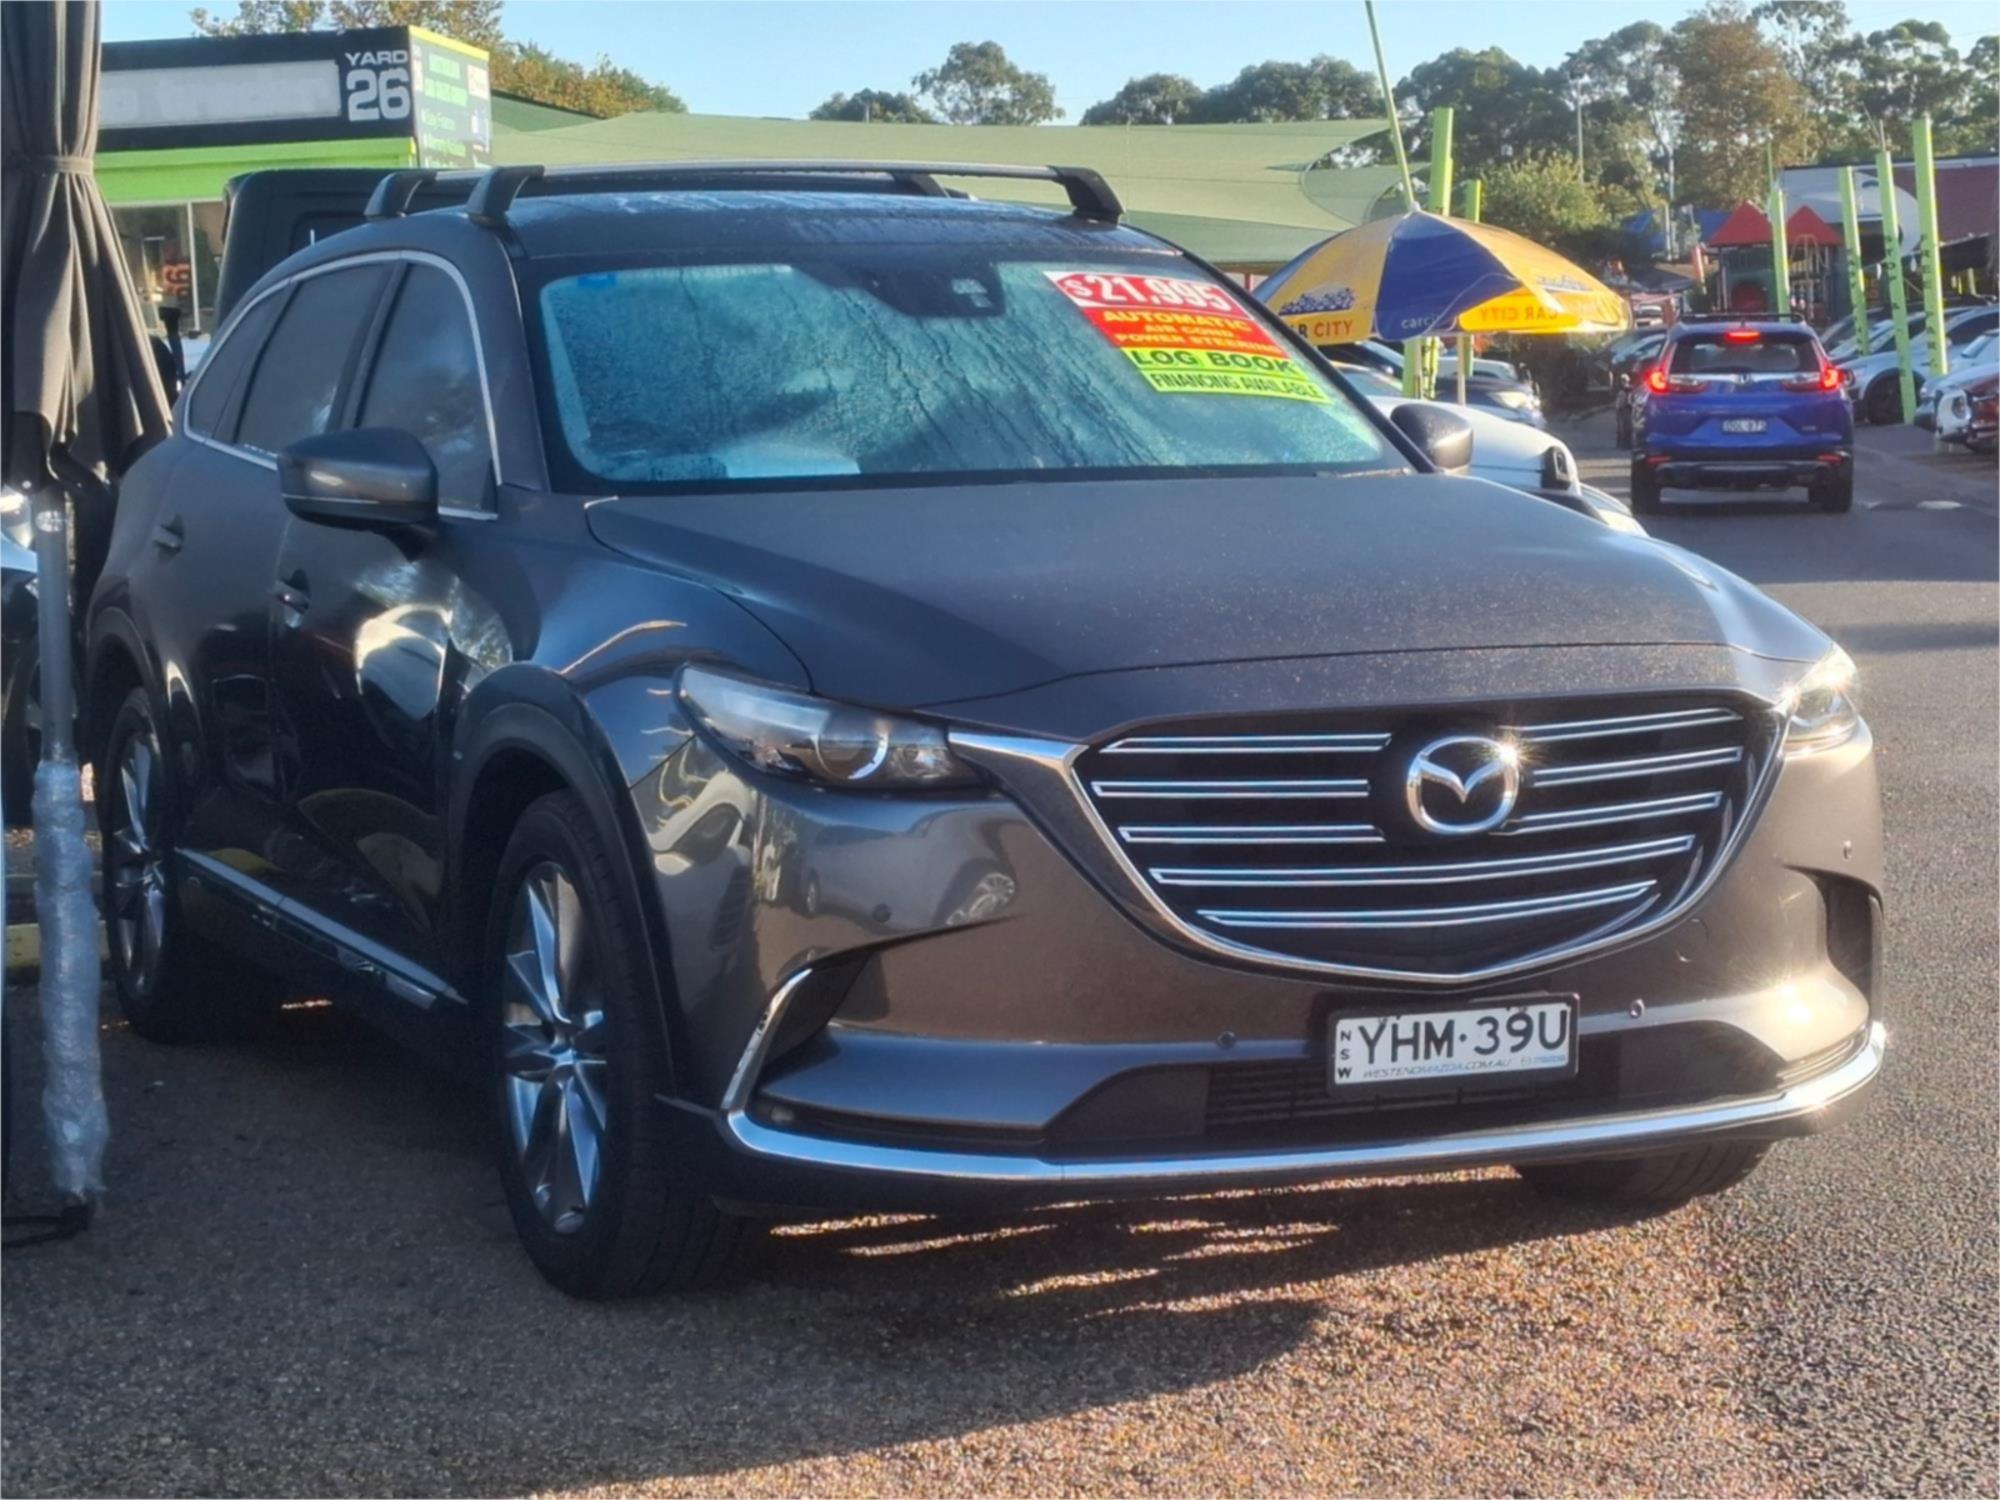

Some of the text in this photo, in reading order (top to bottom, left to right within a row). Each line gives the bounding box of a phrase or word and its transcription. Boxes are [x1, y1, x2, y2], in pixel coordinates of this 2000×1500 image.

[345, 50, 408, 66] YARD
[346, 67, 411, 122] 26
[1064, 274, 1233, 312] $21,995
[1102, 310, 1253, 333] AUTOMATIC
[1144, 323, 1179, 335] AIR
[1313, 320, 1354, 338] CITY
[1113, 333, 1285, 355] POWER STEERING
[1130, 350, 1296, 373] LOG BOOK
[1149, 373, 1324, 400] FINANCING AVAILABLE
